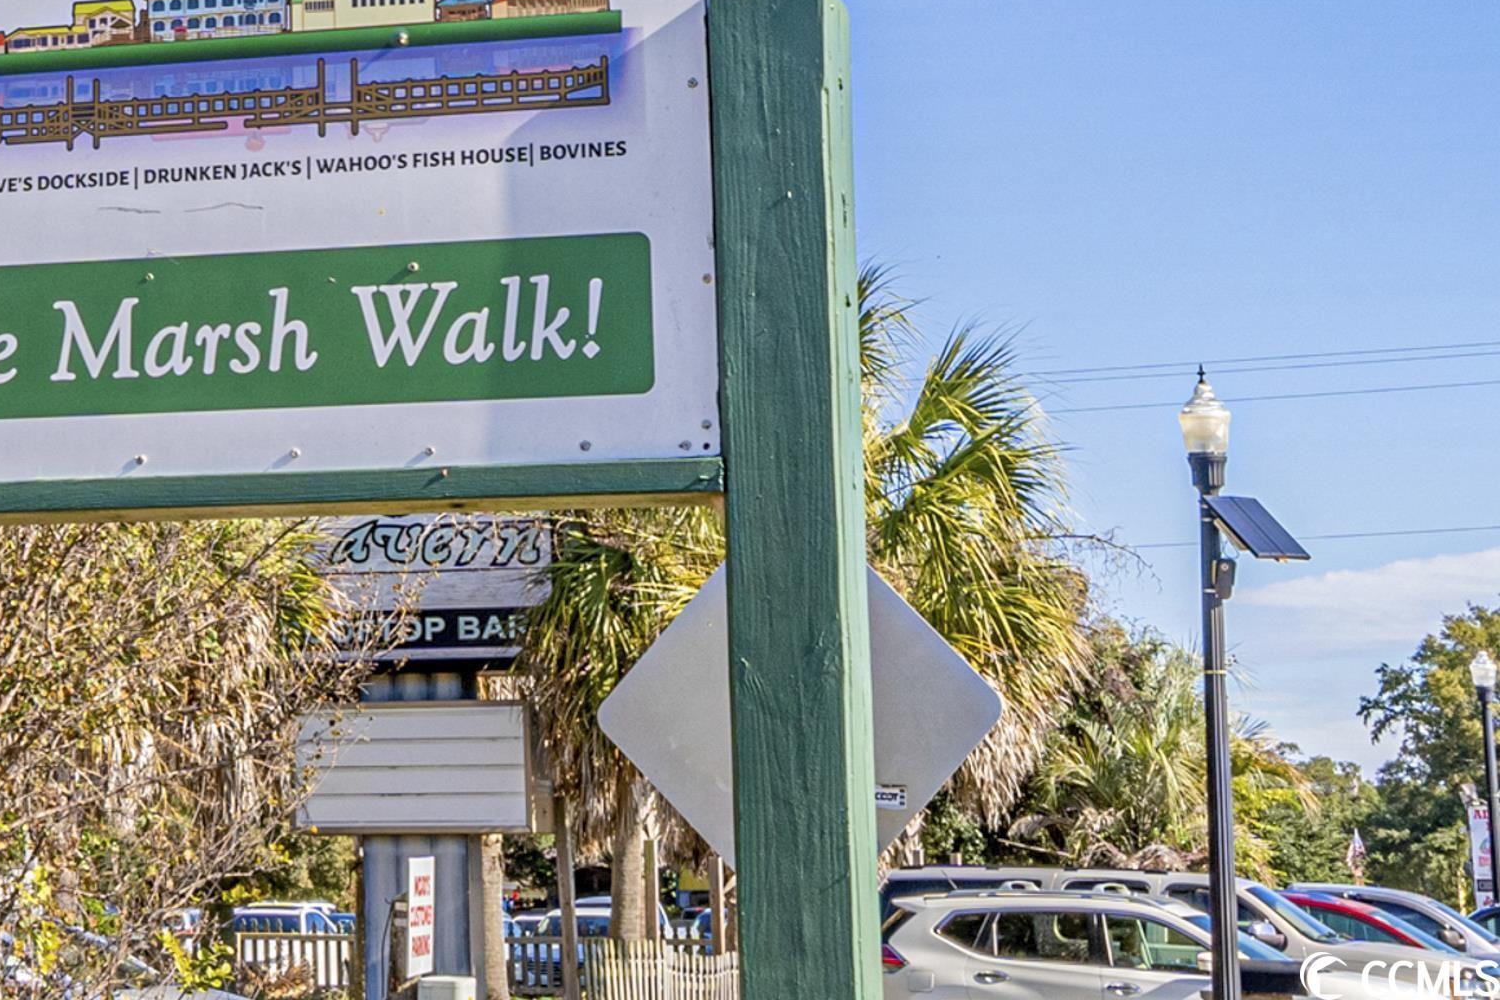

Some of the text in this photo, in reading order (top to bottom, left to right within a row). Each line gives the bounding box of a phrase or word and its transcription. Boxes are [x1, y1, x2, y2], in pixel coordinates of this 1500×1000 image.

[38, 171, 129, 190] DOCKSIDE
[144, 164, 237, 184] DRUNKEN
[241, 160, 302, 180] JACK'S
[316, 154, 408, 174] WAHOO'S
[413, 151, 455, 168] FISH
[461, 147, 527, 165] HOUSE
[540, 140, 627, 161] BOVINES
[50, 287, 319, 381] Marsh
[351, 274, 603, 368] Walk!
